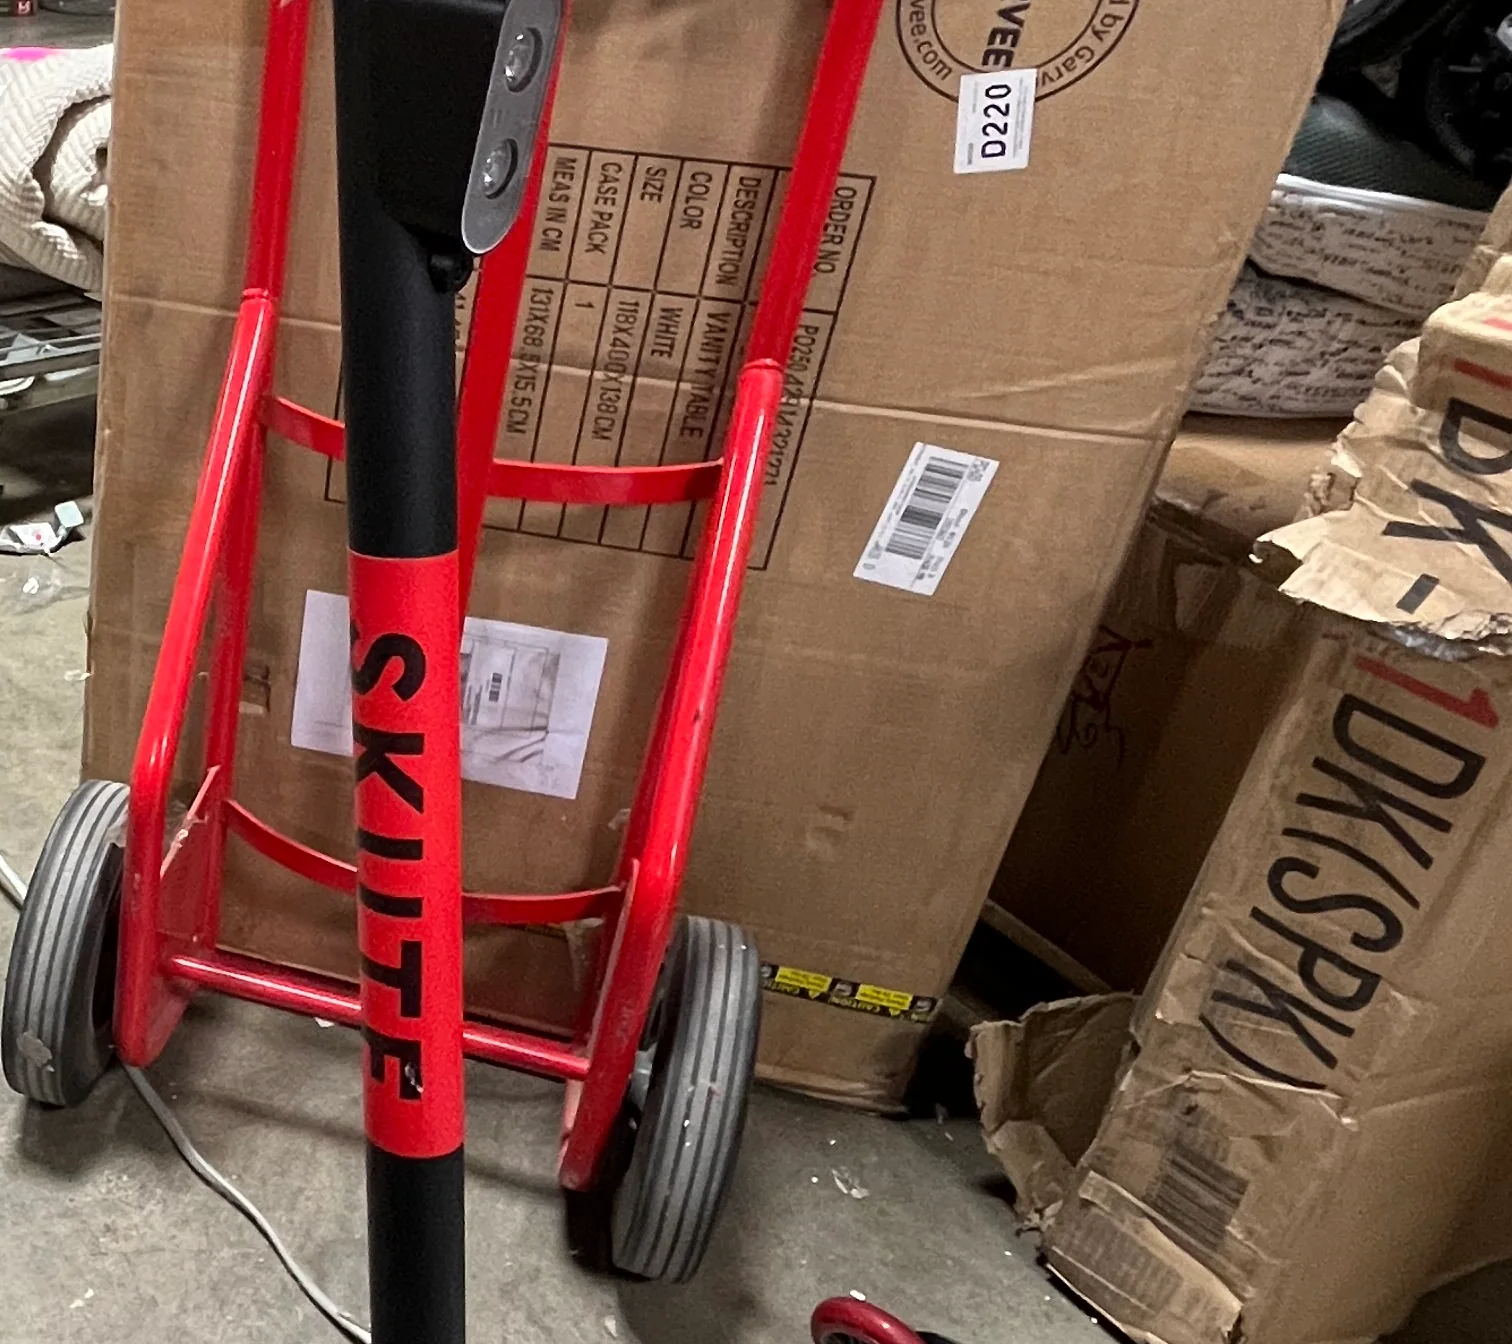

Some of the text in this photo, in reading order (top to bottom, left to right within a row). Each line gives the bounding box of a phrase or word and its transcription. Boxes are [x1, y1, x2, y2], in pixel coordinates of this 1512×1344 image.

[1092, 13, 1124, 41] by
[981, 83, 1012, 158] D220
[538, 157, 577, 253] MEAS IN CM
[585, 161, 623, 254] CASE PACK
[640, 166, 667, 204] SIZE
[678, 171, 713, 231] COLOR
[823, 187, 857, 246] ORDER
[716, 175, 762, 287] DESCRIPTION
[650, 306, 684, 359] WHITE
[679, 310, 732, 440] VANITY TABLE
